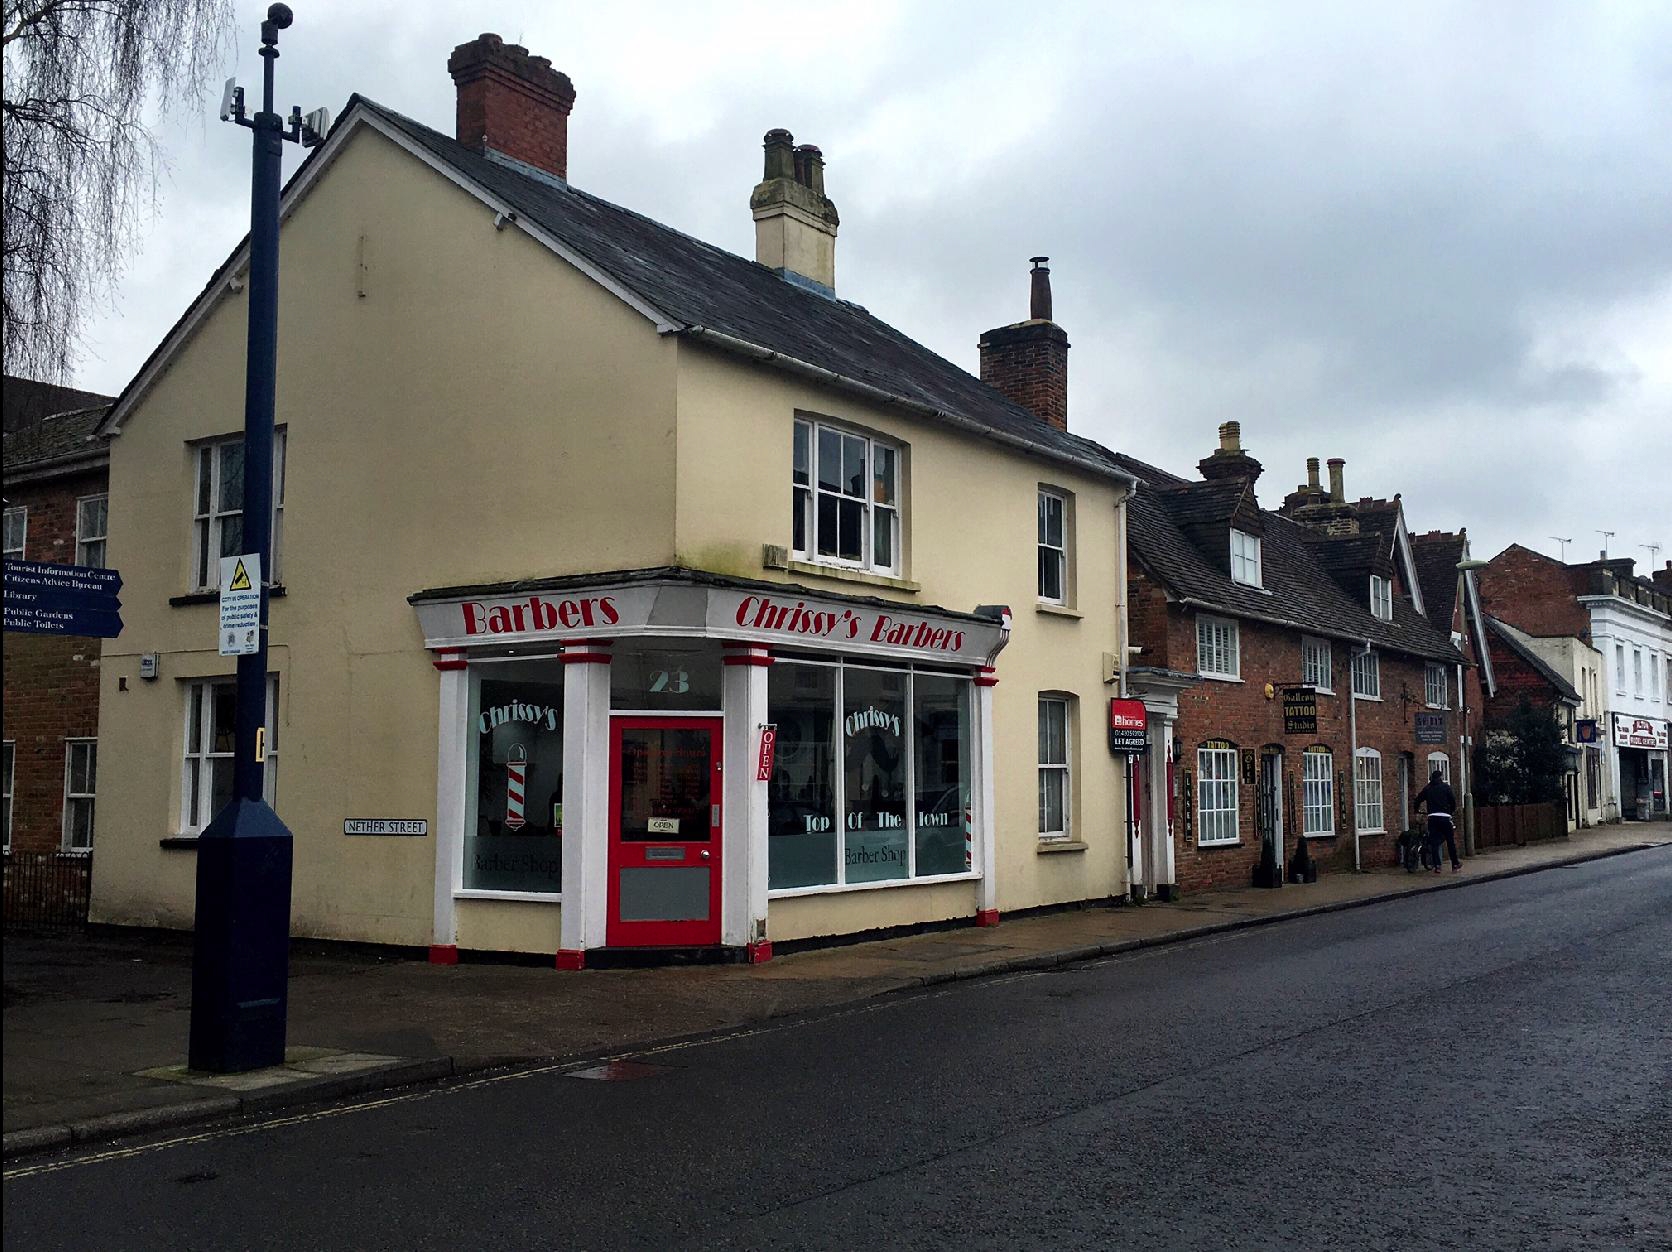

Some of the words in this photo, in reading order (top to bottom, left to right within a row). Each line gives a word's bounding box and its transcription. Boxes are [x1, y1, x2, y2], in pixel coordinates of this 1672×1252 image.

[4, 573, 41, 584] Citizens
[42, 577, 71, 587] Advice
[72, 580, 103, 590] Bureau
[5, 562, 35, 572] Tourist
[38, 565, 86, 578] Information
[87, 570, 116, 581] Centre
[3, 589, 38, 601] Library
[3, 618, 32, 627] Public
[33, 620, 65, 629] Toilets
[4, 607, 33, 616] Public
[35, 609, 74, 620] Gardens
[461, 596, 620, 635] Barbers
[735, 596, 862, 639] Chrissy's
[869, 615, 966, 652] Barbers
[650, 671, 689, 694] 23
[479, 699, 558, 735] Chrissy's
[1284, 705, 1316, 717] TATTOO
[845, 705, 900, 738] Chrissy's
[759, 731, 774, 779] OPEN
[348, 820, 385, 832] NETHER
[389, 822, 423, 833] STREET
[652, 820, 675, 830] OPEN
[803, 814, 830, 834] Top
[848, 811, 863, 829] Of
[877, 811, 902, 828] The
[845, 847, 879, 866] Barber
[881, 845, 906, 867] Shop
